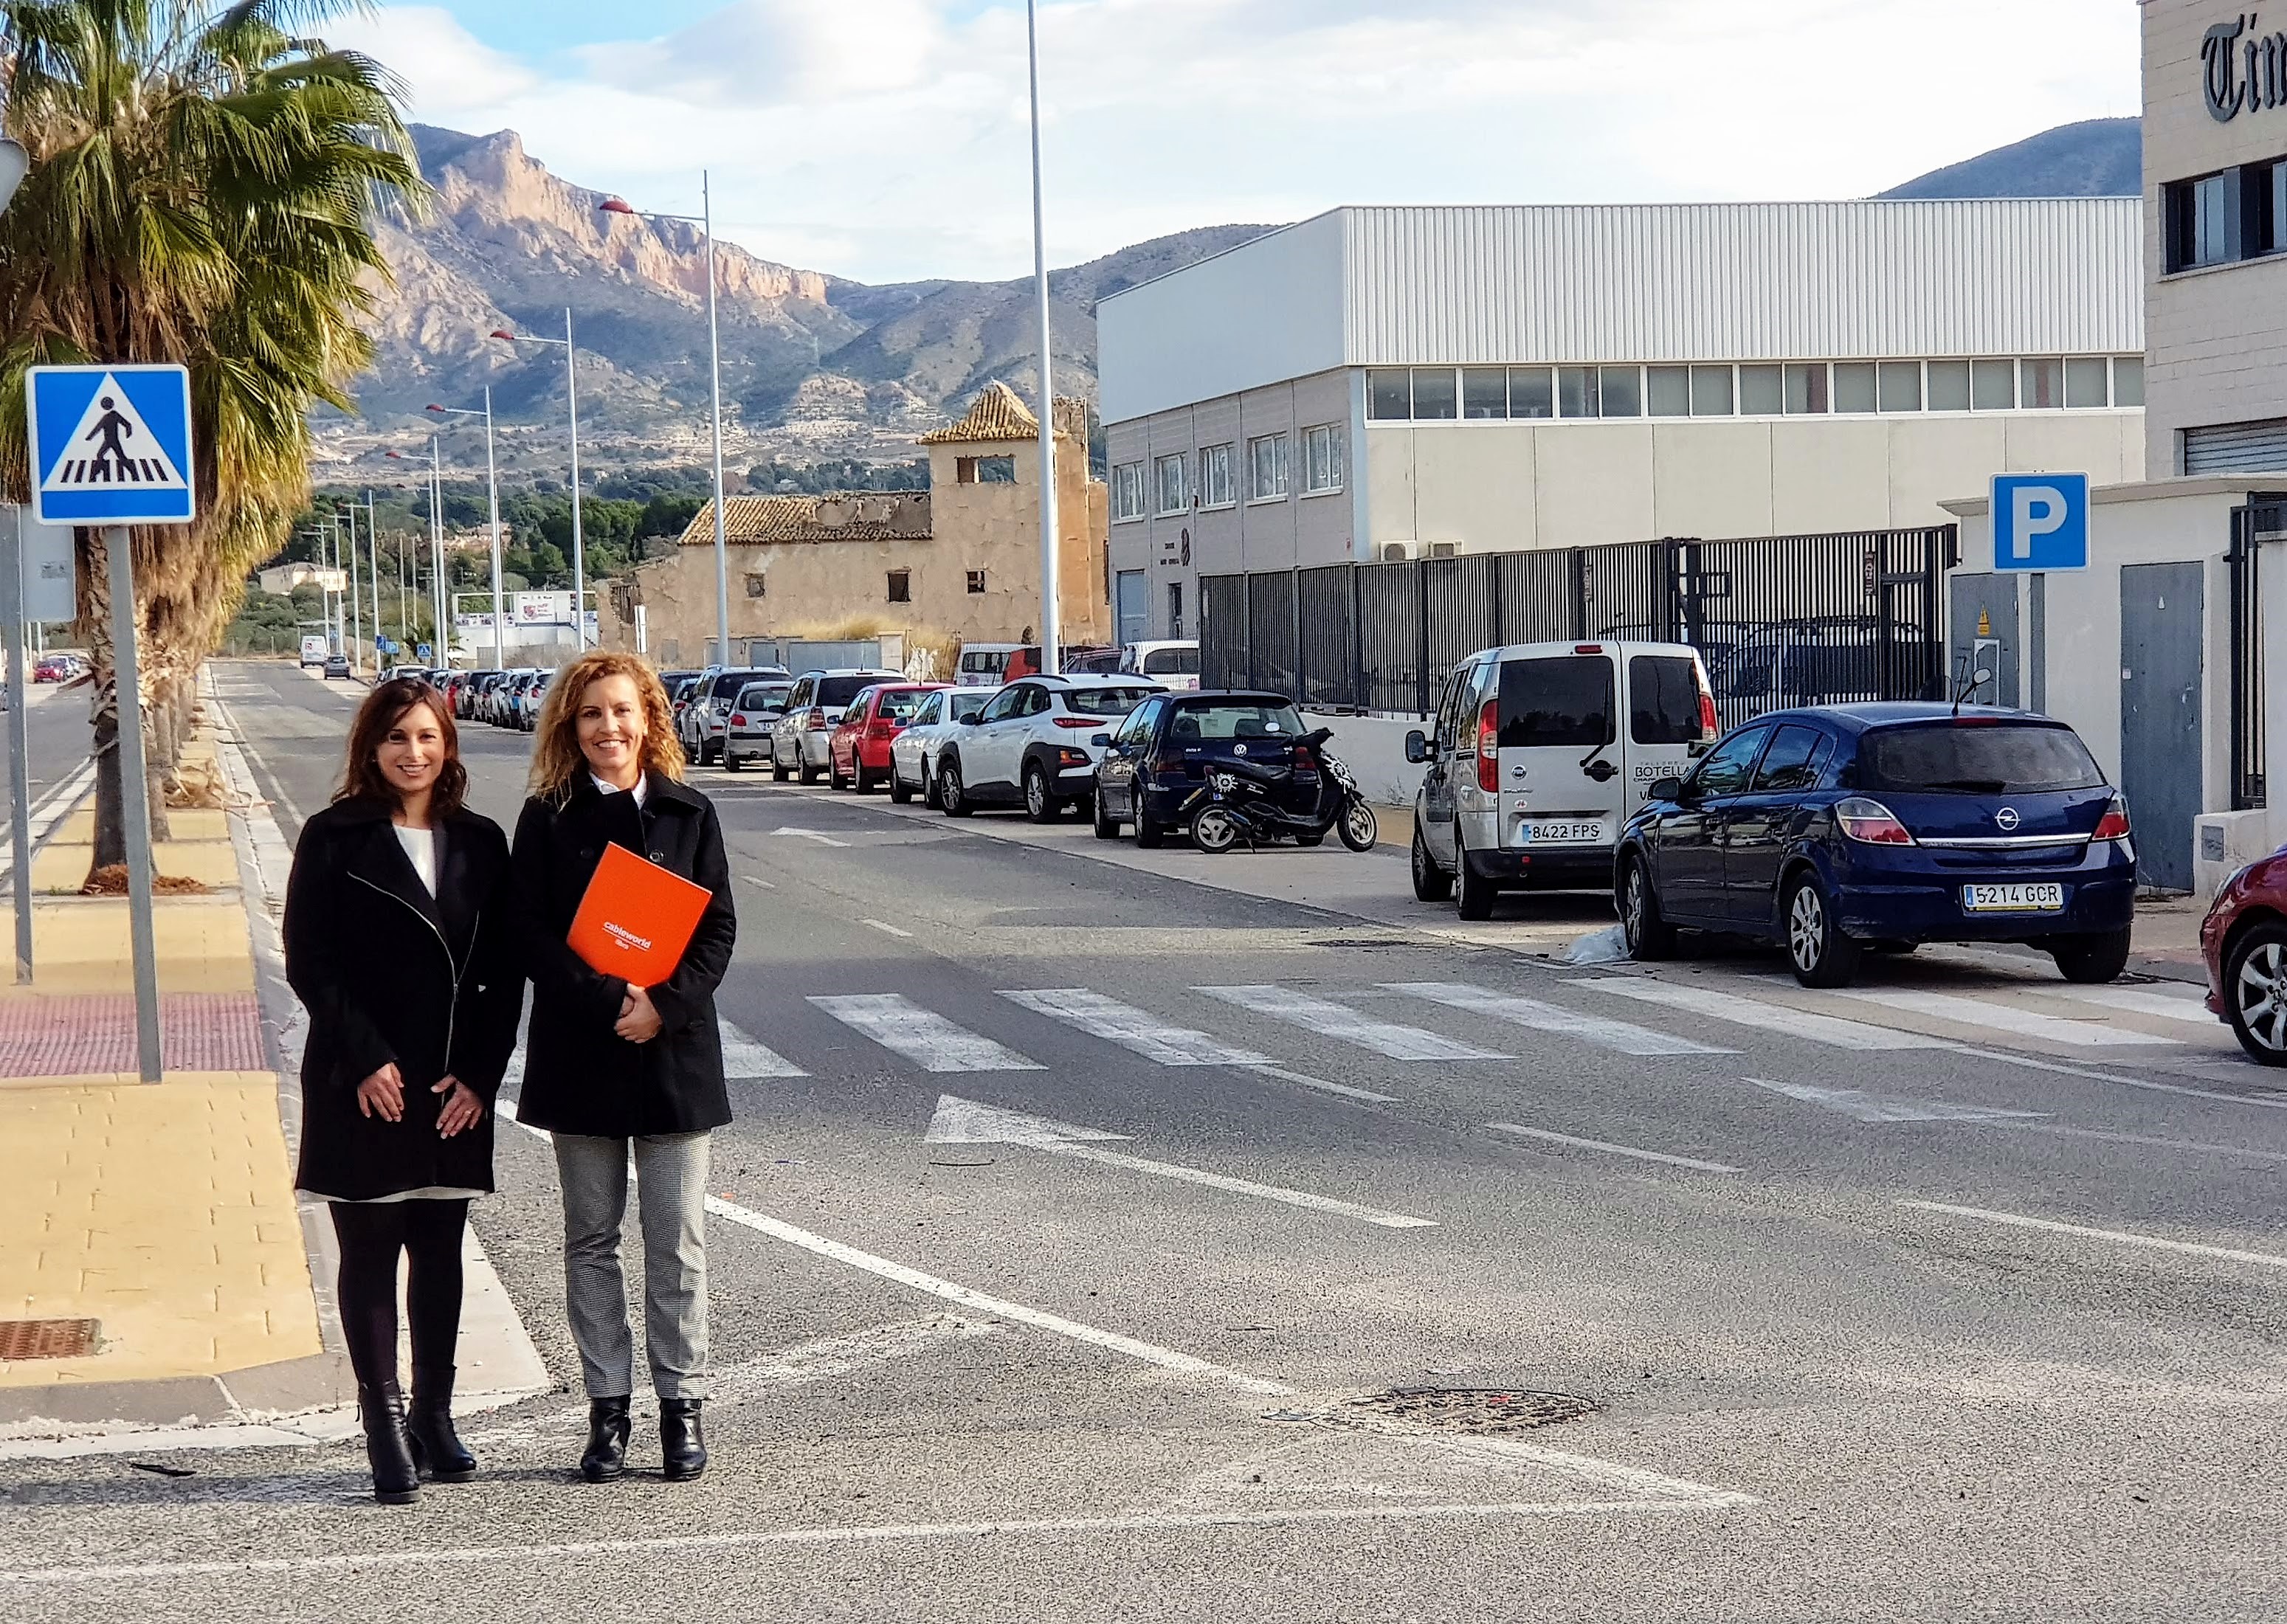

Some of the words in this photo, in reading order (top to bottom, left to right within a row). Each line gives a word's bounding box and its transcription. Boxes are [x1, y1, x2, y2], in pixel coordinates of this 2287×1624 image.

[2012, 486, 2068, 559] P
[1533, 826, 1567, 838] 8422
[1573, 824, 1599, 837] FPS
[1976, 887, 2020, 903] 5214
[2025, 885, 2058, 902] GCR
[604, 922, 652, 949] cableworld
